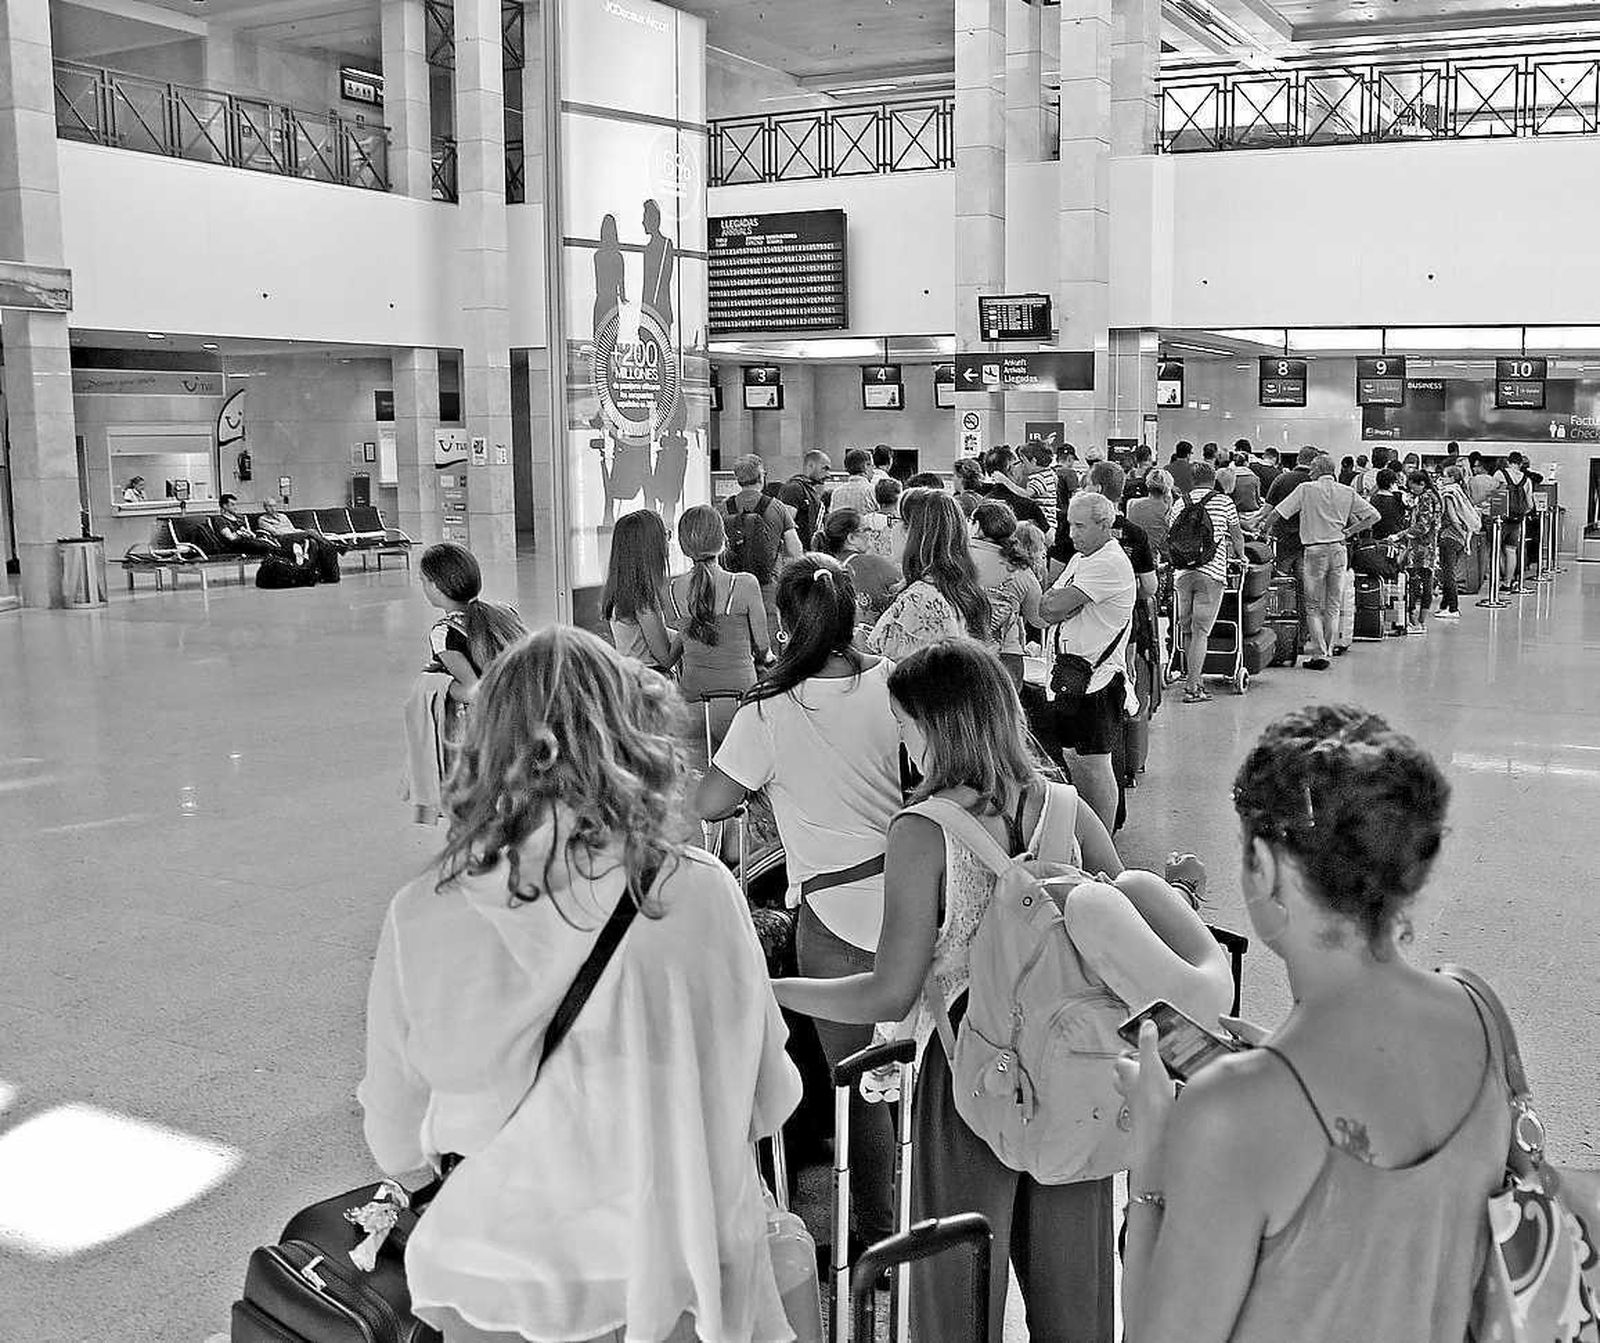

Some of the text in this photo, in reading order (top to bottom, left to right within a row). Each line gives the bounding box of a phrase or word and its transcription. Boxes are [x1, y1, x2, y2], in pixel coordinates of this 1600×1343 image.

[721, 218, 759, 229] LLEGADAS
[610, 341, 658, 367] +200
[613, 366, 659, 379] MILLONES
[876, 367, 887, 382] 4
[1004, 366, 1027, 374] Arrivals
[1278, 361, 1289, 376] 8
[1376, 360, 1387, 375] 9
[1510, 362, 1533, 377] 10
[757, 368, 767, 383] 3
[1004, 374, 1039, 384] Llegadas
[1407, 382, 1442, 390] BUSINESS
